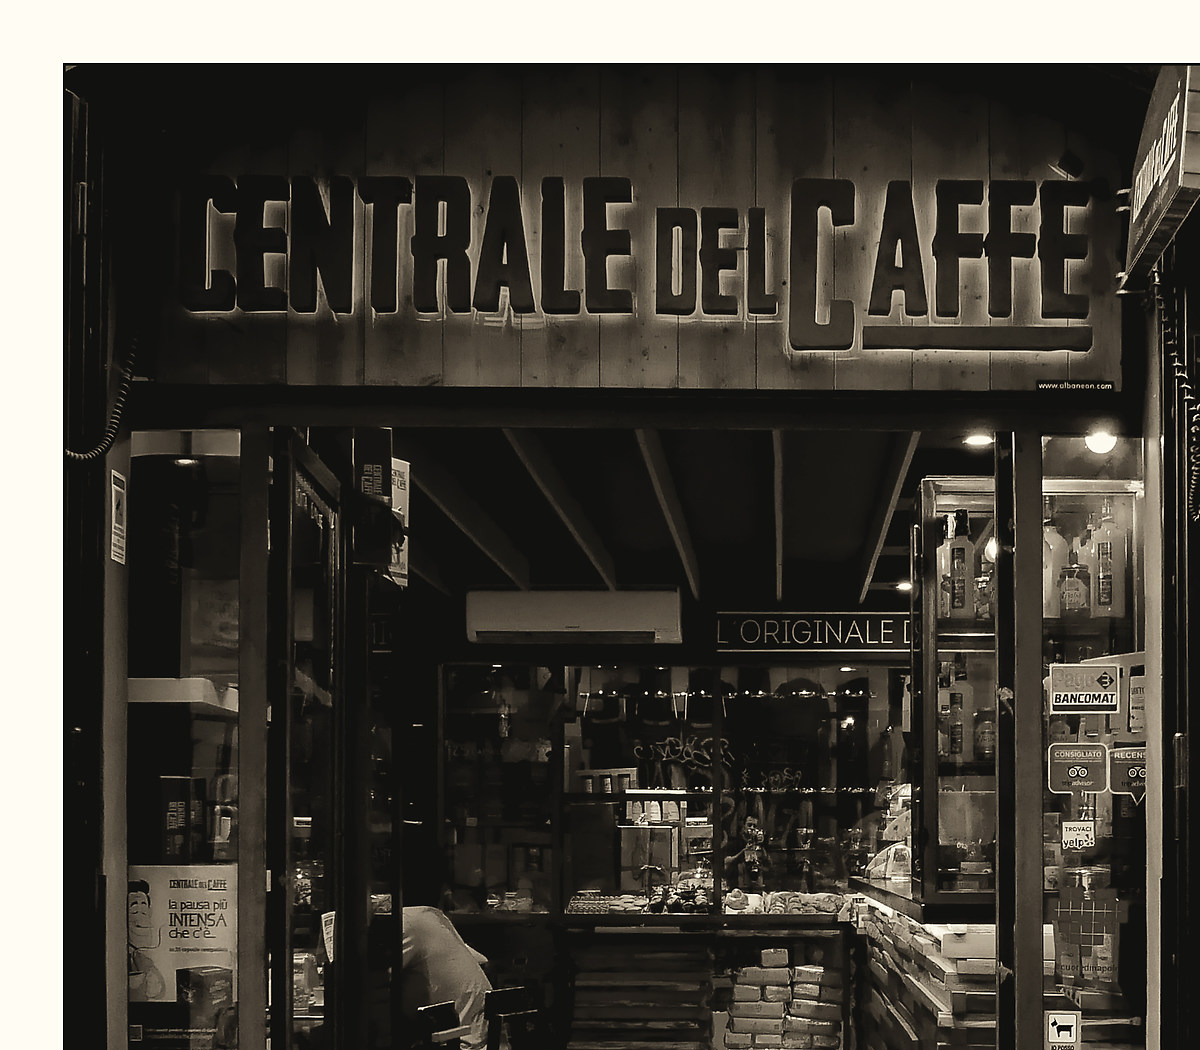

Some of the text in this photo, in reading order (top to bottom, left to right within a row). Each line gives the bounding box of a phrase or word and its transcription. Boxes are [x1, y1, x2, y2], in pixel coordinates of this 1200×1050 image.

[181, 174, 633, 314] CENTRALE
[655, 207, 778, 315] DEL
[717, 619, 894, 645] L'ORIGINALE
[1054, 693, 1116, 704] BANCOMAT
[1062, 837, 1085, 849] yelp
[169, 879, 198, 889] CENTRALE
[169, 899, 178, 910] la
[181, 901, 210, 912] pausa
[169, 912, 228, 927] INTENSA
[169, 927, 190, 939] che
